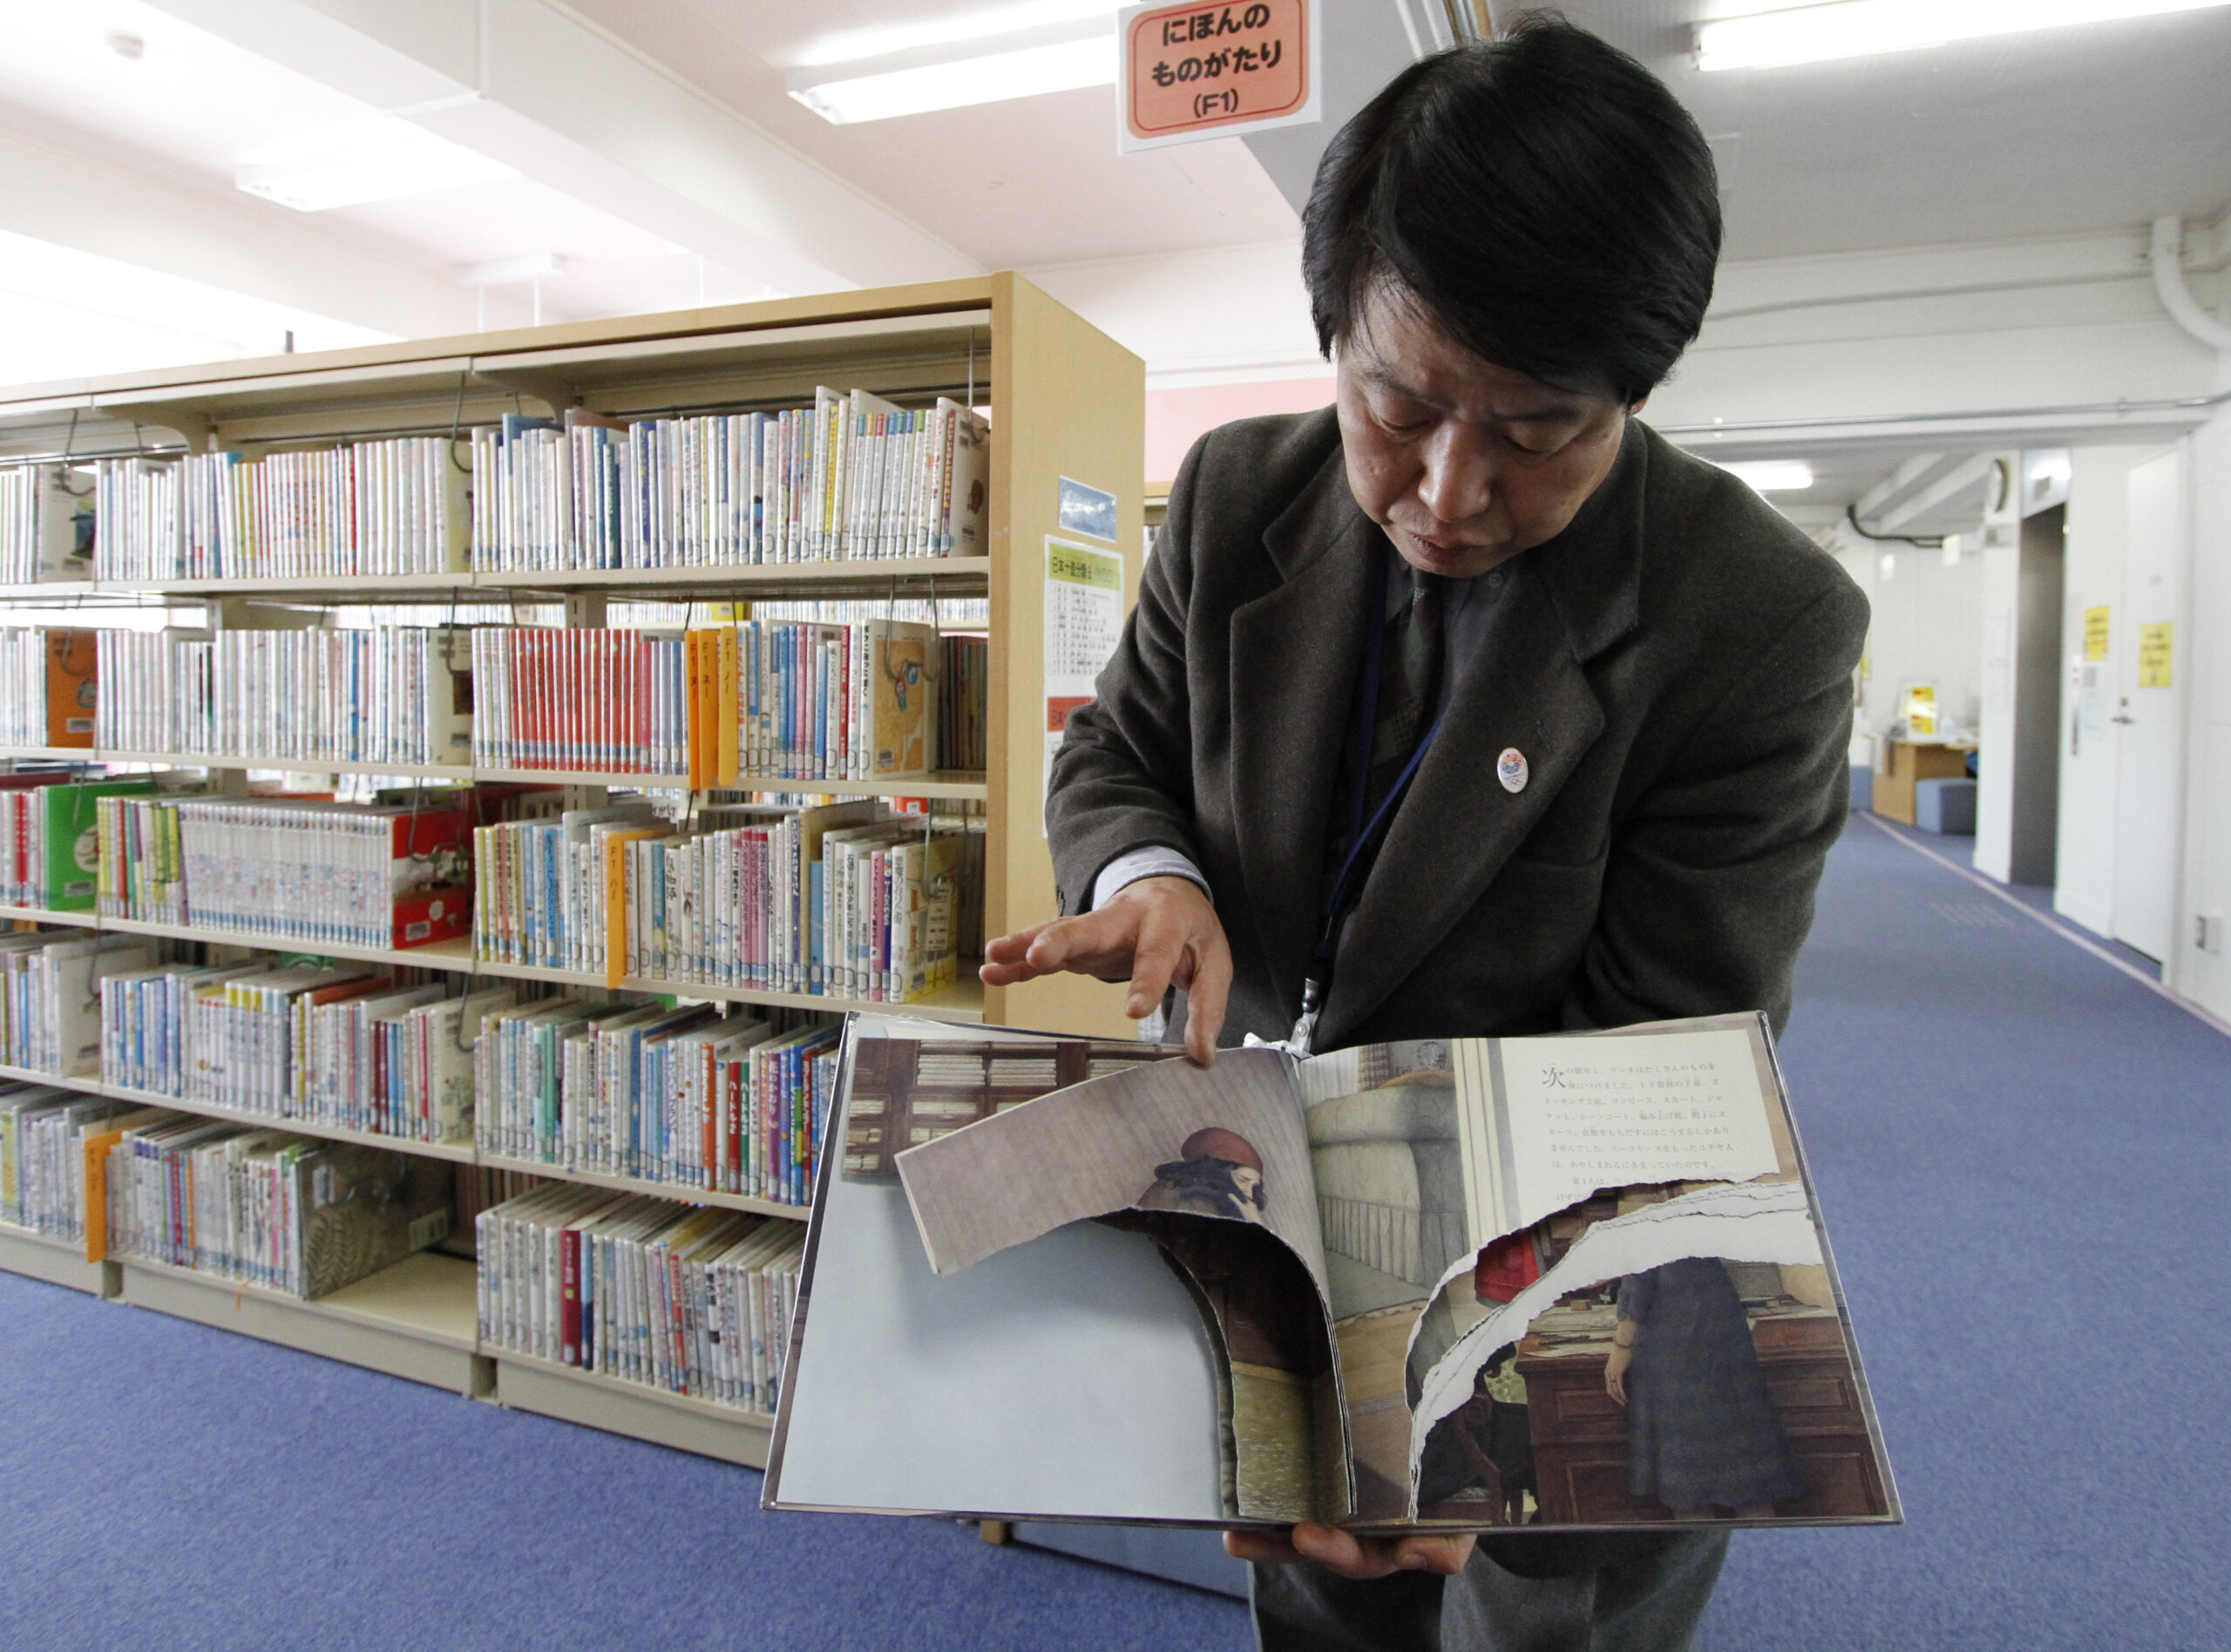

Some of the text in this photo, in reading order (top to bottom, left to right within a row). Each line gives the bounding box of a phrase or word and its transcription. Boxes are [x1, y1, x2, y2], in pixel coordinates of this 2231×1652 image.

[1163, 3, 1270, 46] にほんの
[1151, 39, 1282, 87] ものがたり
[1193, 88, 1238, 118] (F1)
[1541, 1066, 1567, 1089] 次
